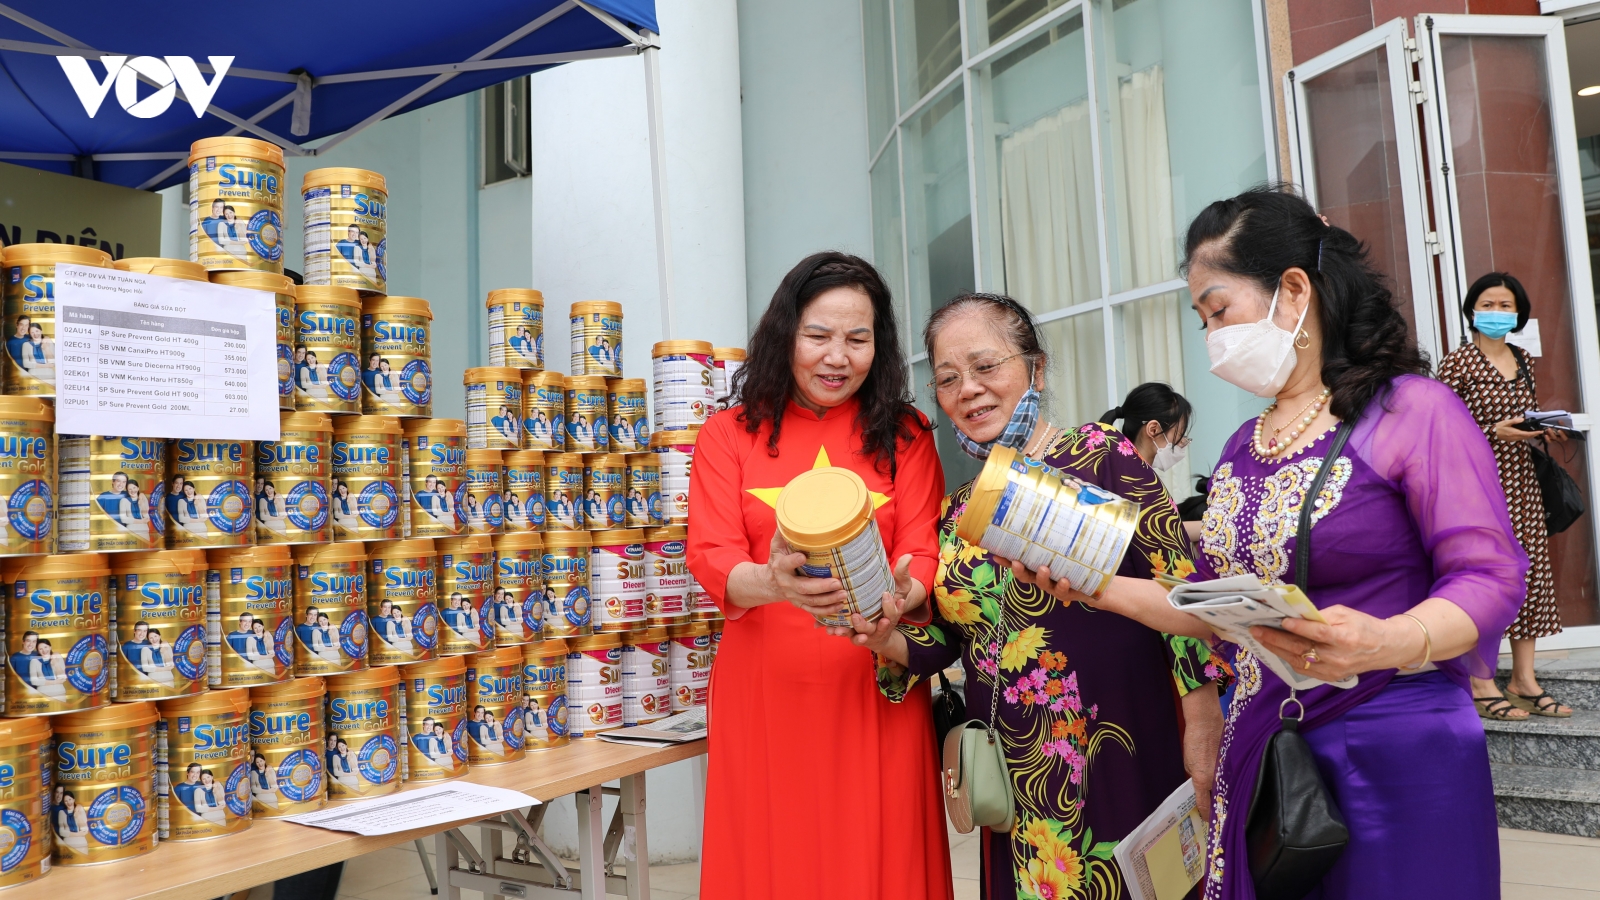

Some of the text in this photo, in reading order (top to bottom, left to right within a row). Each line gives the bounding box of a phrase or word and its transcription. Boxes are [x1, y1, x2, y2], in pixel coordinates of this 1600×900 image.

[218, 164, 277, 194] Sure
[218, 189, 277, 205] Prevent Gold
[354, 216, 378, 225] Prevent
[23, 274, 56, 302] Su
[522, 306, 542, 321] Sur
[300, 310, 355, 336] Sure
[64, 326, 92, 334] 02AU14
[128, 333, 153, 341] Prevent
[374, 320, 425, 344] Sure
[64, 340, 91, 348] 02EC13
[128, 346, 158, 355] CanxiPro
[160, 350, 185, 358] HT900g
[333, 336, 356, 348] Gold
[405, 344, 426, 355] Gold
[176, 364, 201, 372] HT900g
[168, 377, 193, 385] HT850g
[577, 394, 605, 406] Sure
[618, 396, 645, 408] Sure
[0, 436, 46, 459] ure
[178, 439, 242, 463] Sure
[259, 441, 319, 464] Sure
[333, 442, 389, 465] Sure
[431, 443, 466, 465] Sur
[17, 460, 46, 474] Gold
[214, 463, 242, 475] Gold
[292, 464, 319, 475] Gold
[363, 465, 389, 476] Gold
[466, 469, 498, 483] Sure
[508, 469, 540, 483] Sure
[592, 470, 622, 483] Sure
[632, 470, 659, 482] Sure
[542, 554, 586, 574] Sure
[617, 561, 645, 579] Sur
[311, 572, 364, 596] Sure
[385, 566, 434, 589] Sure
[30, 589, 102, 618] Sure
[141, 582, 203, 609] Sure
[141, 607, 203, 620] Prevent Gold
[30, 615, 102, 629] Prevent Gold
[523, 664, 565, 684] Sure
[652, 658, 668, 677] Su
[478, 674, 520, 696] Sure
[331, 698, 388, 722] Sure
[250, 711, 310, 736] Sure
[363, 718, 388, 732] Gold
[194, 723, 249, 750] Sure
[283, 732, 310, 746] Gold
[58, 741, 131, 771] Sure
[194, 751, 228, 760] Prevent
[58, 766, 131, 782] Prevent Gold
